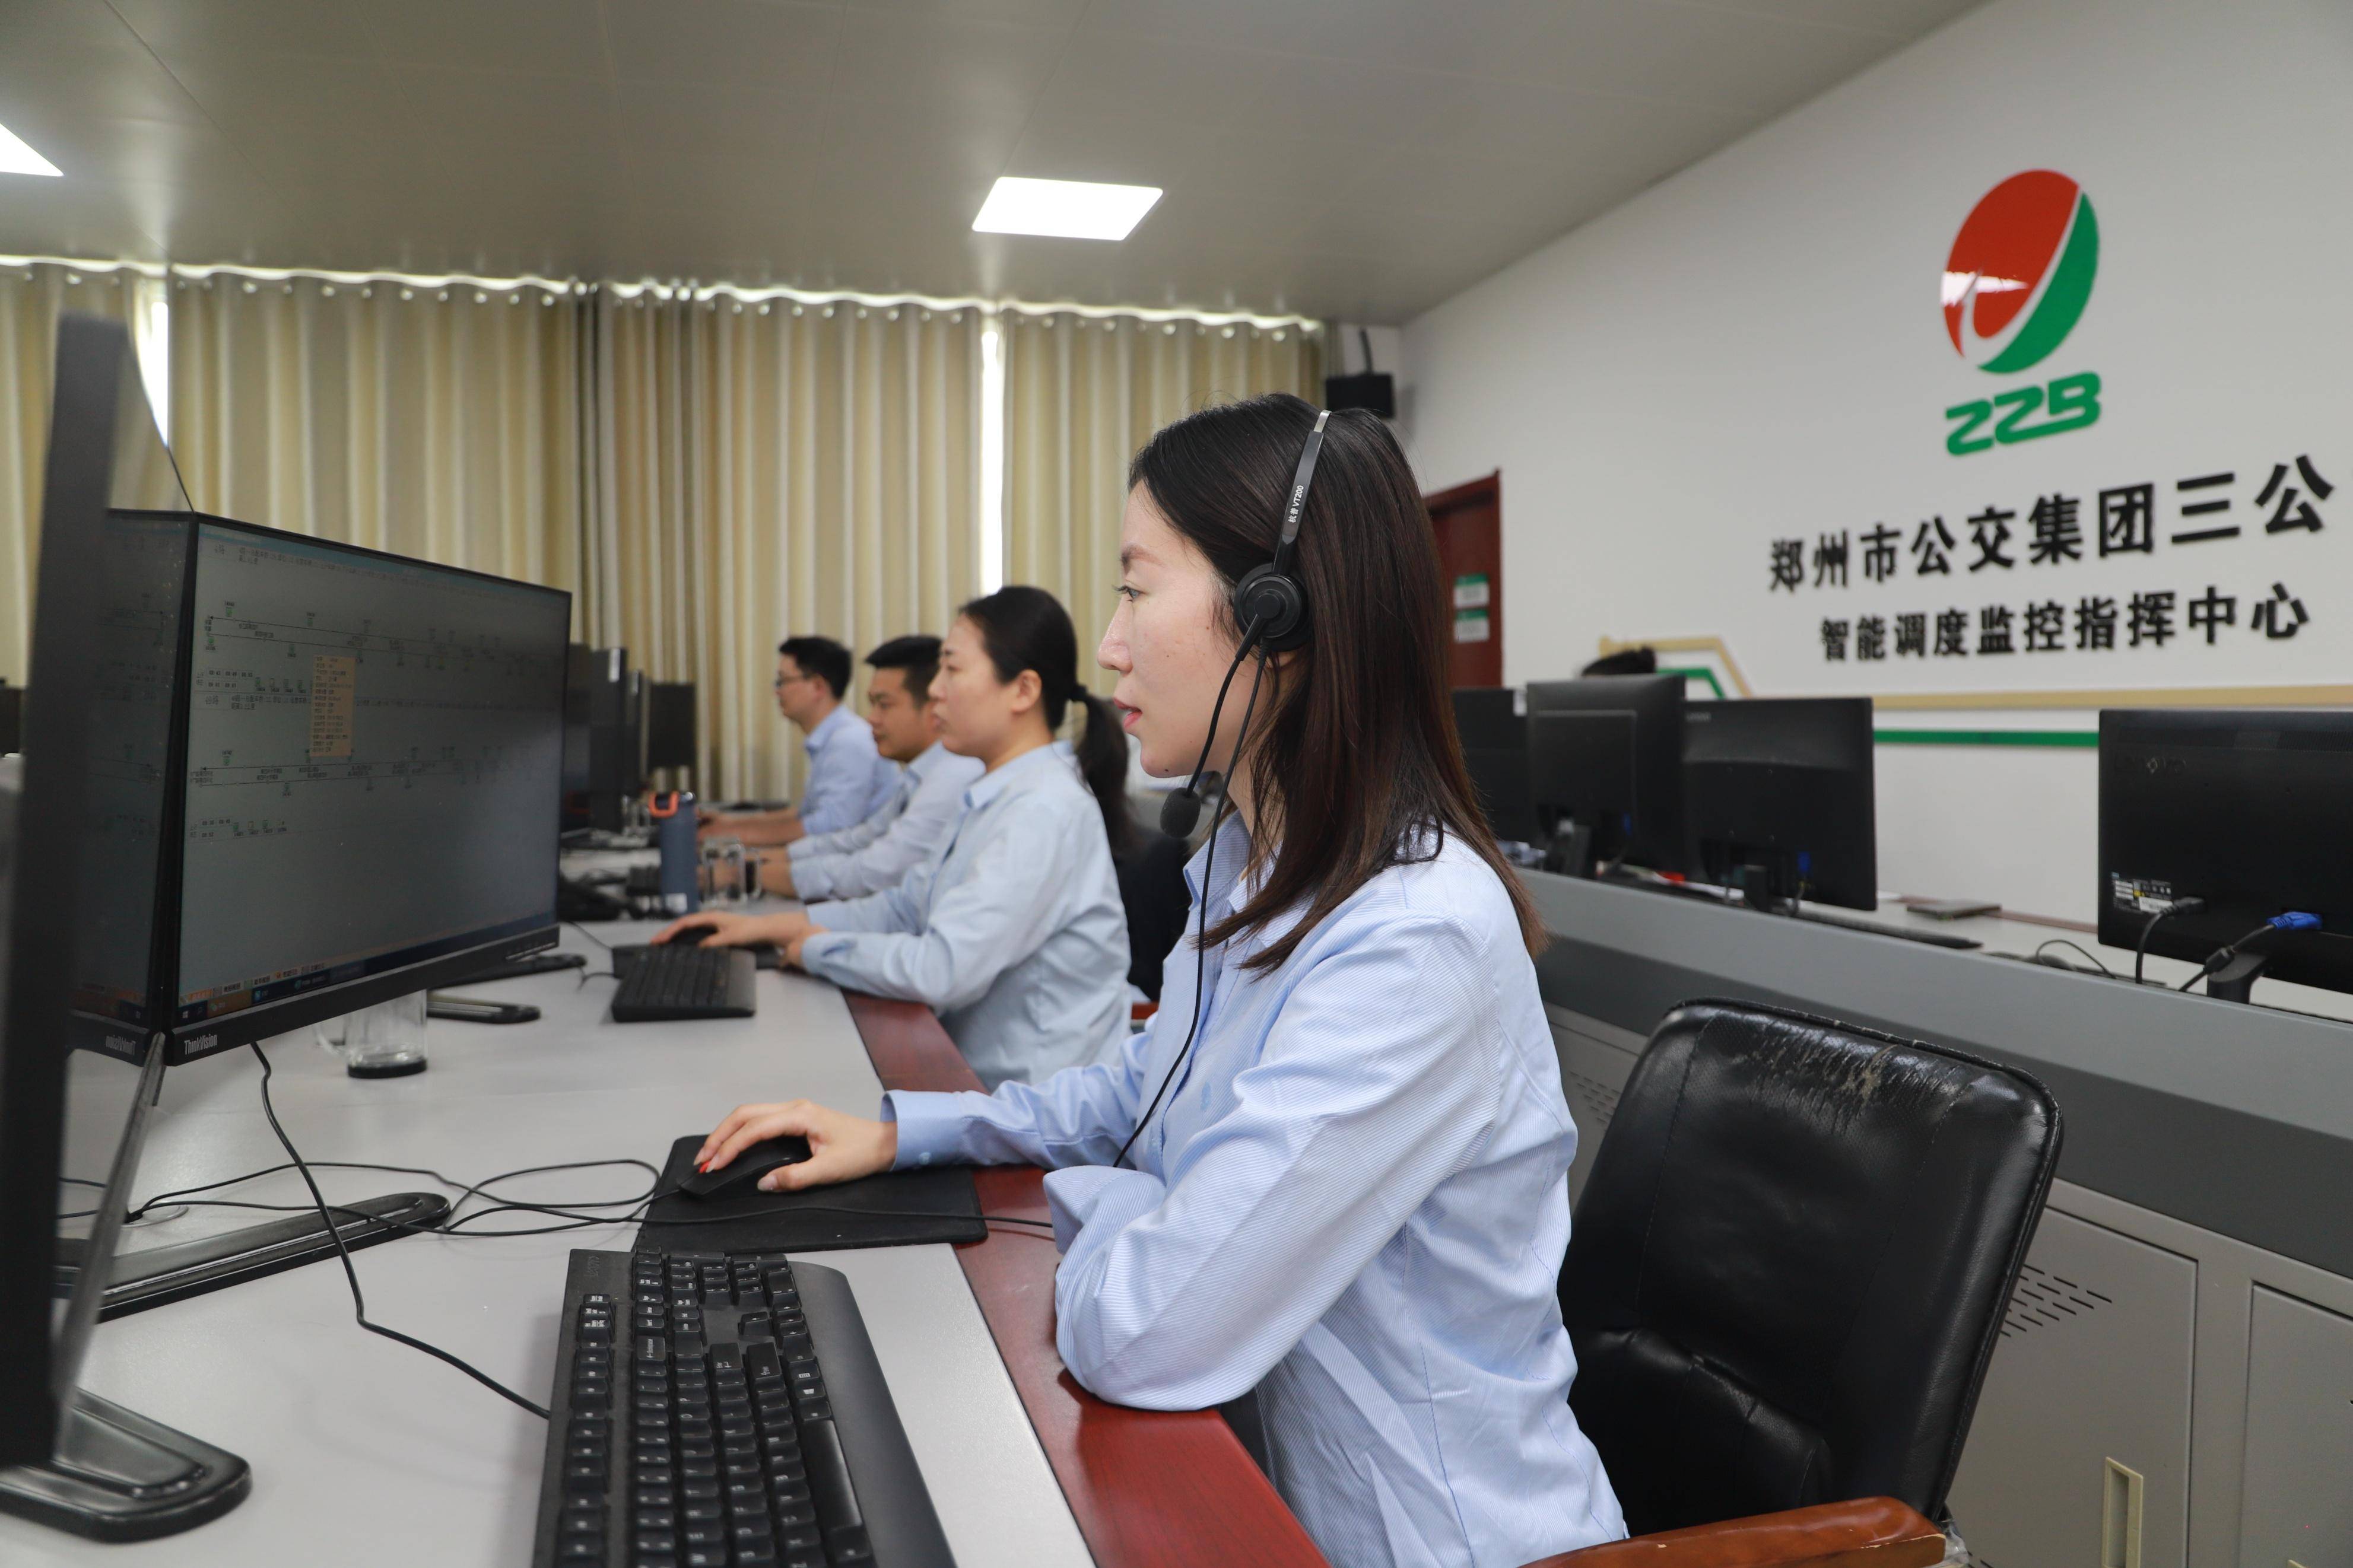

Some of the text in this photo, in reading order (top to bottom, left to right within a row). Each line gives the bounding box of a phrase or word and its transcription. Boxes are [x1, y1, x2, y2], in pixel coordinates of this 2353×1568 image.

[1946, 373, 2101, 456] ZZB
[1292, 485, 1304, 507] VT200
[1770, 455, 2335, 593] 郑州市公交集团三公
[1821, 583, 2310, 661] 智能调度监控指挥中心
[184, 1033, 217, 1055] ThinkVision
